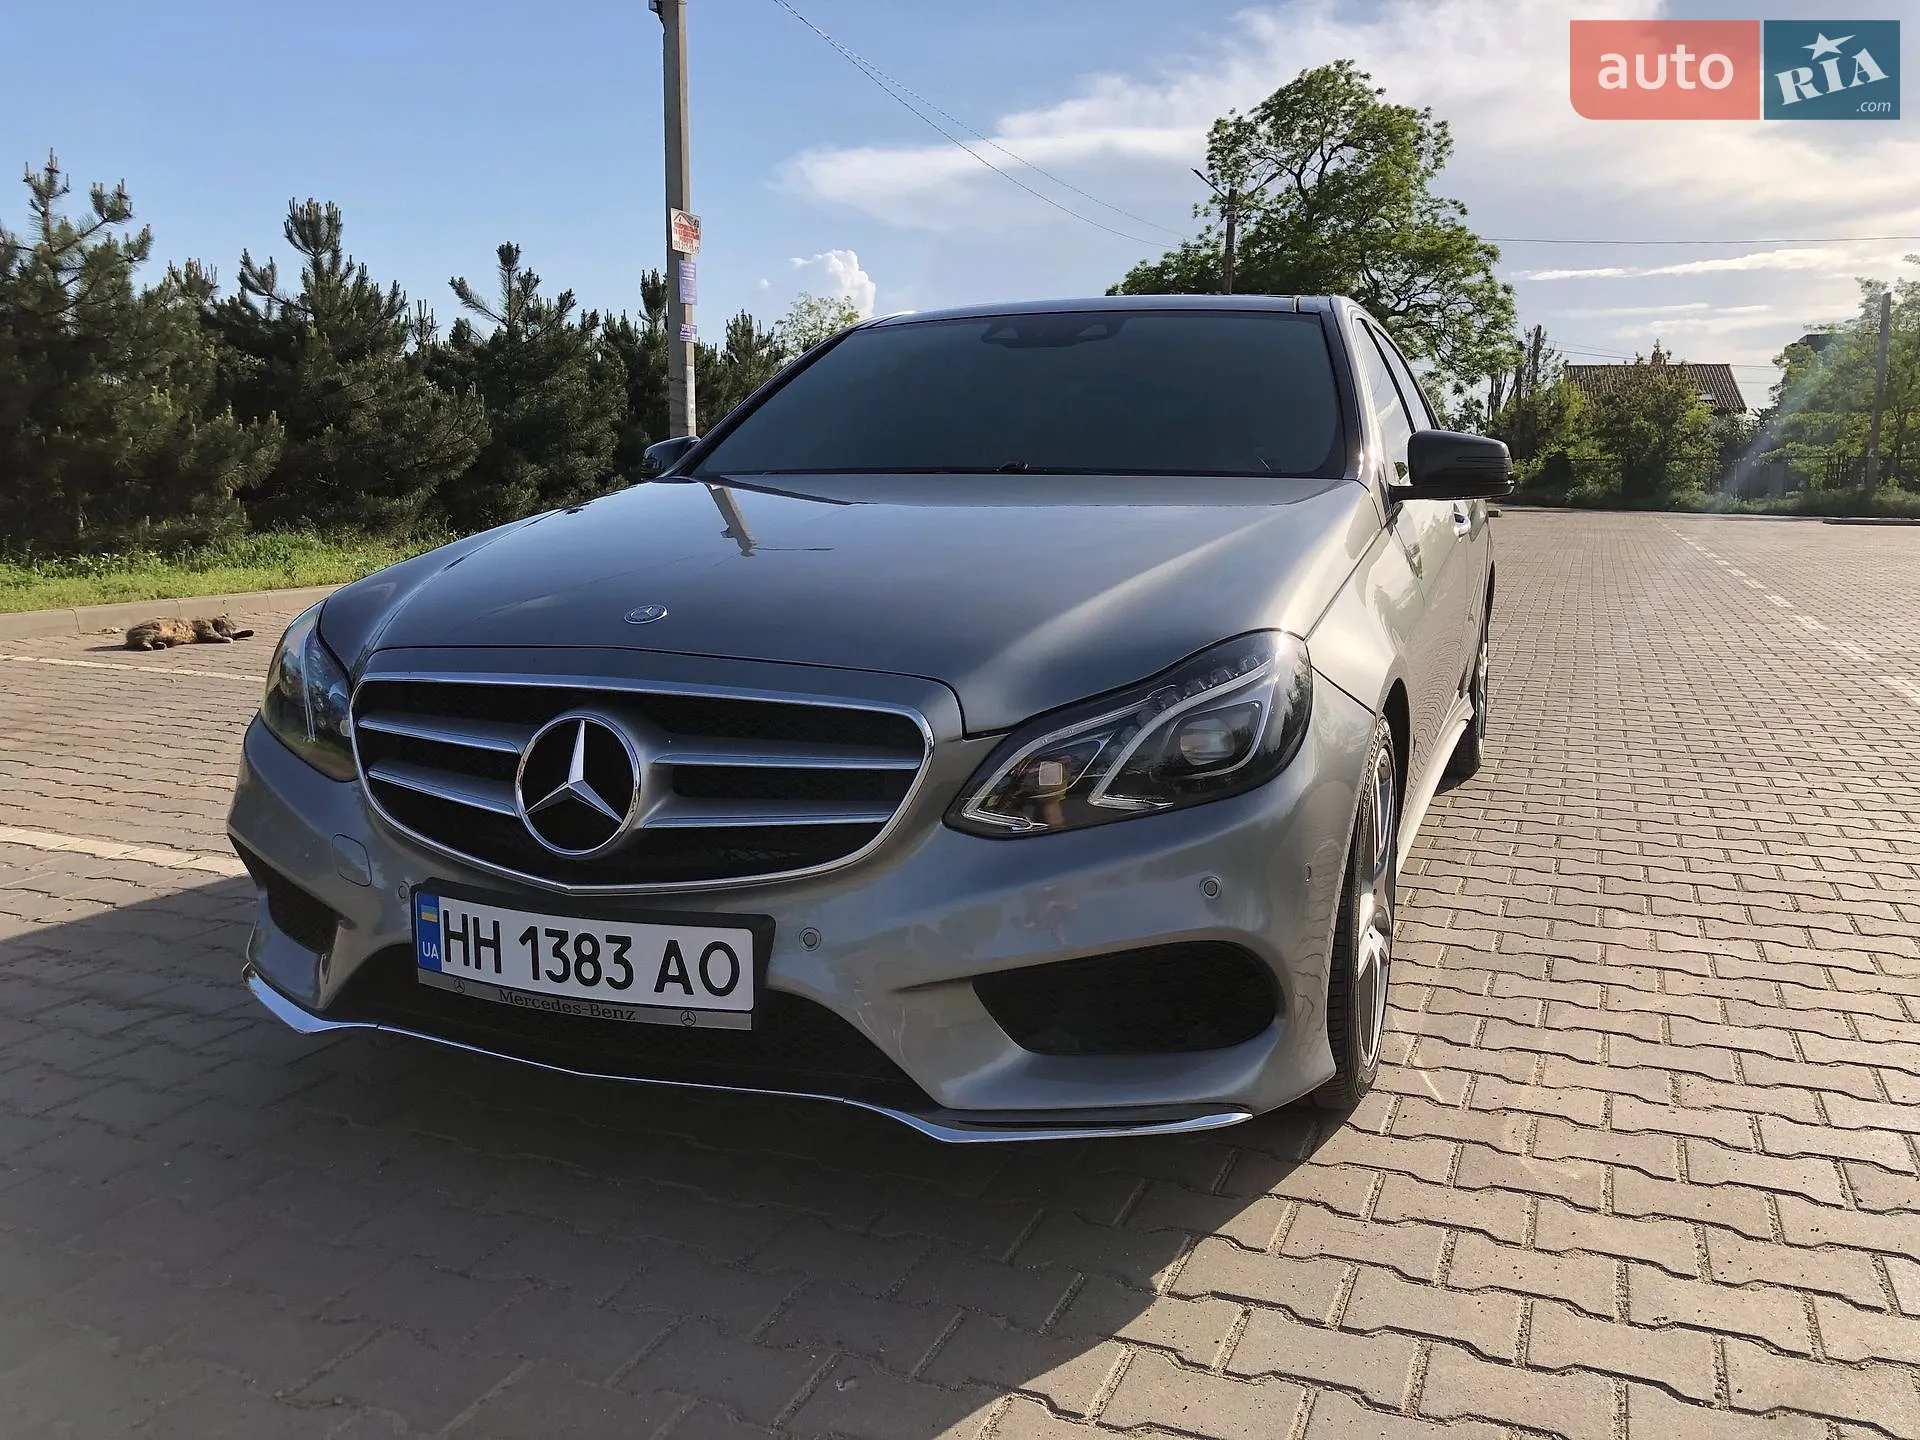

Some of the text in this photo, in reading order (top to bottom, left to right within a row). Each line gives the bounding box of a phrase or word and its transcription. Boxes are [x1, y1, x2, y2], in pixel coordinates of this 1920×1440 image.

[422, 941, 439, 960] UA
[443, 909, 740, 997] HH 1383 AO
[499, 988, 637, 1021] Mercedes-Benz
